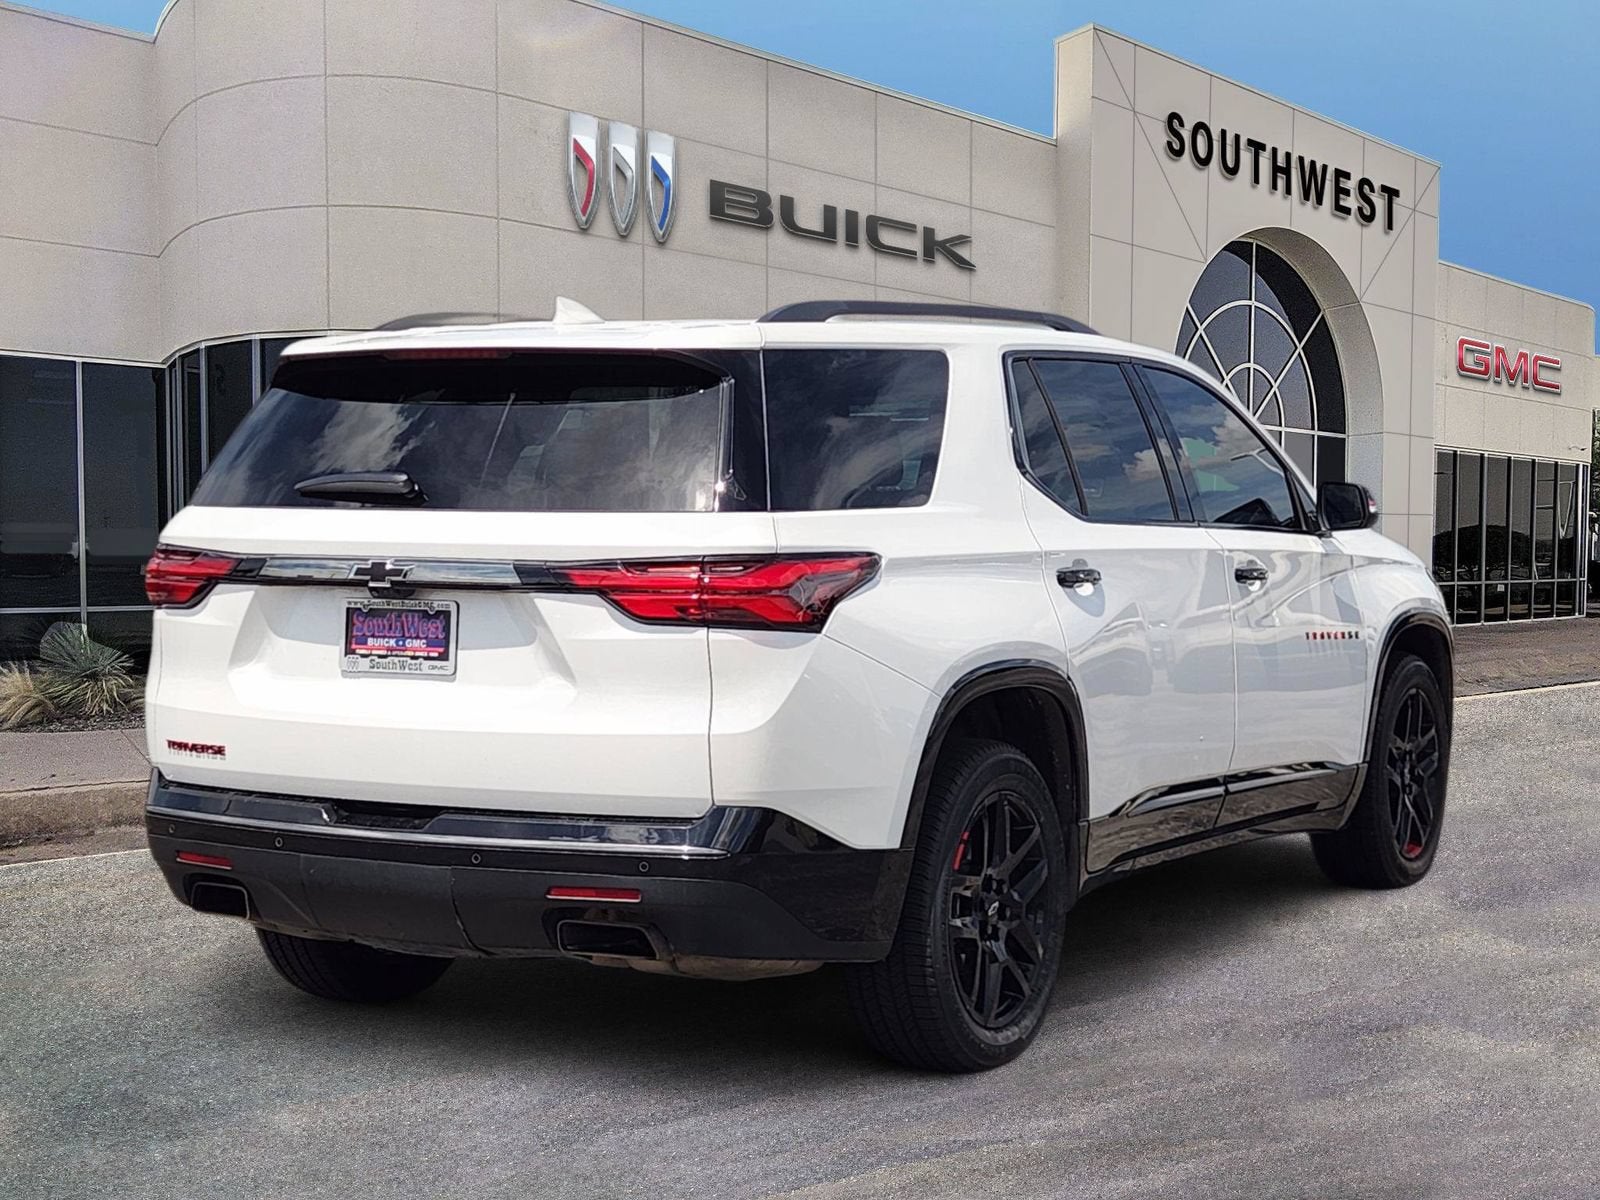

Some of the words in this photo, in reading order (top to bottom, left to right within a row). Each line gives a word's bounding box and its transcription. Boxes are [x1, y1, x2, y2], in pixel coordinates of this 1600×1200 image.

[1166, 111, 1400, 233] SOUTHWEST
[709, 179, 977, 270] BUICK
[1457, 336, 1561, 394] GMC
[367, 637, 397, 647] BUICK
[405, 639, 427, 648] GMC
[1305, 631, 1360, 640] TRAVERSE
[166, 739, 226, 756] TRAVERSE
